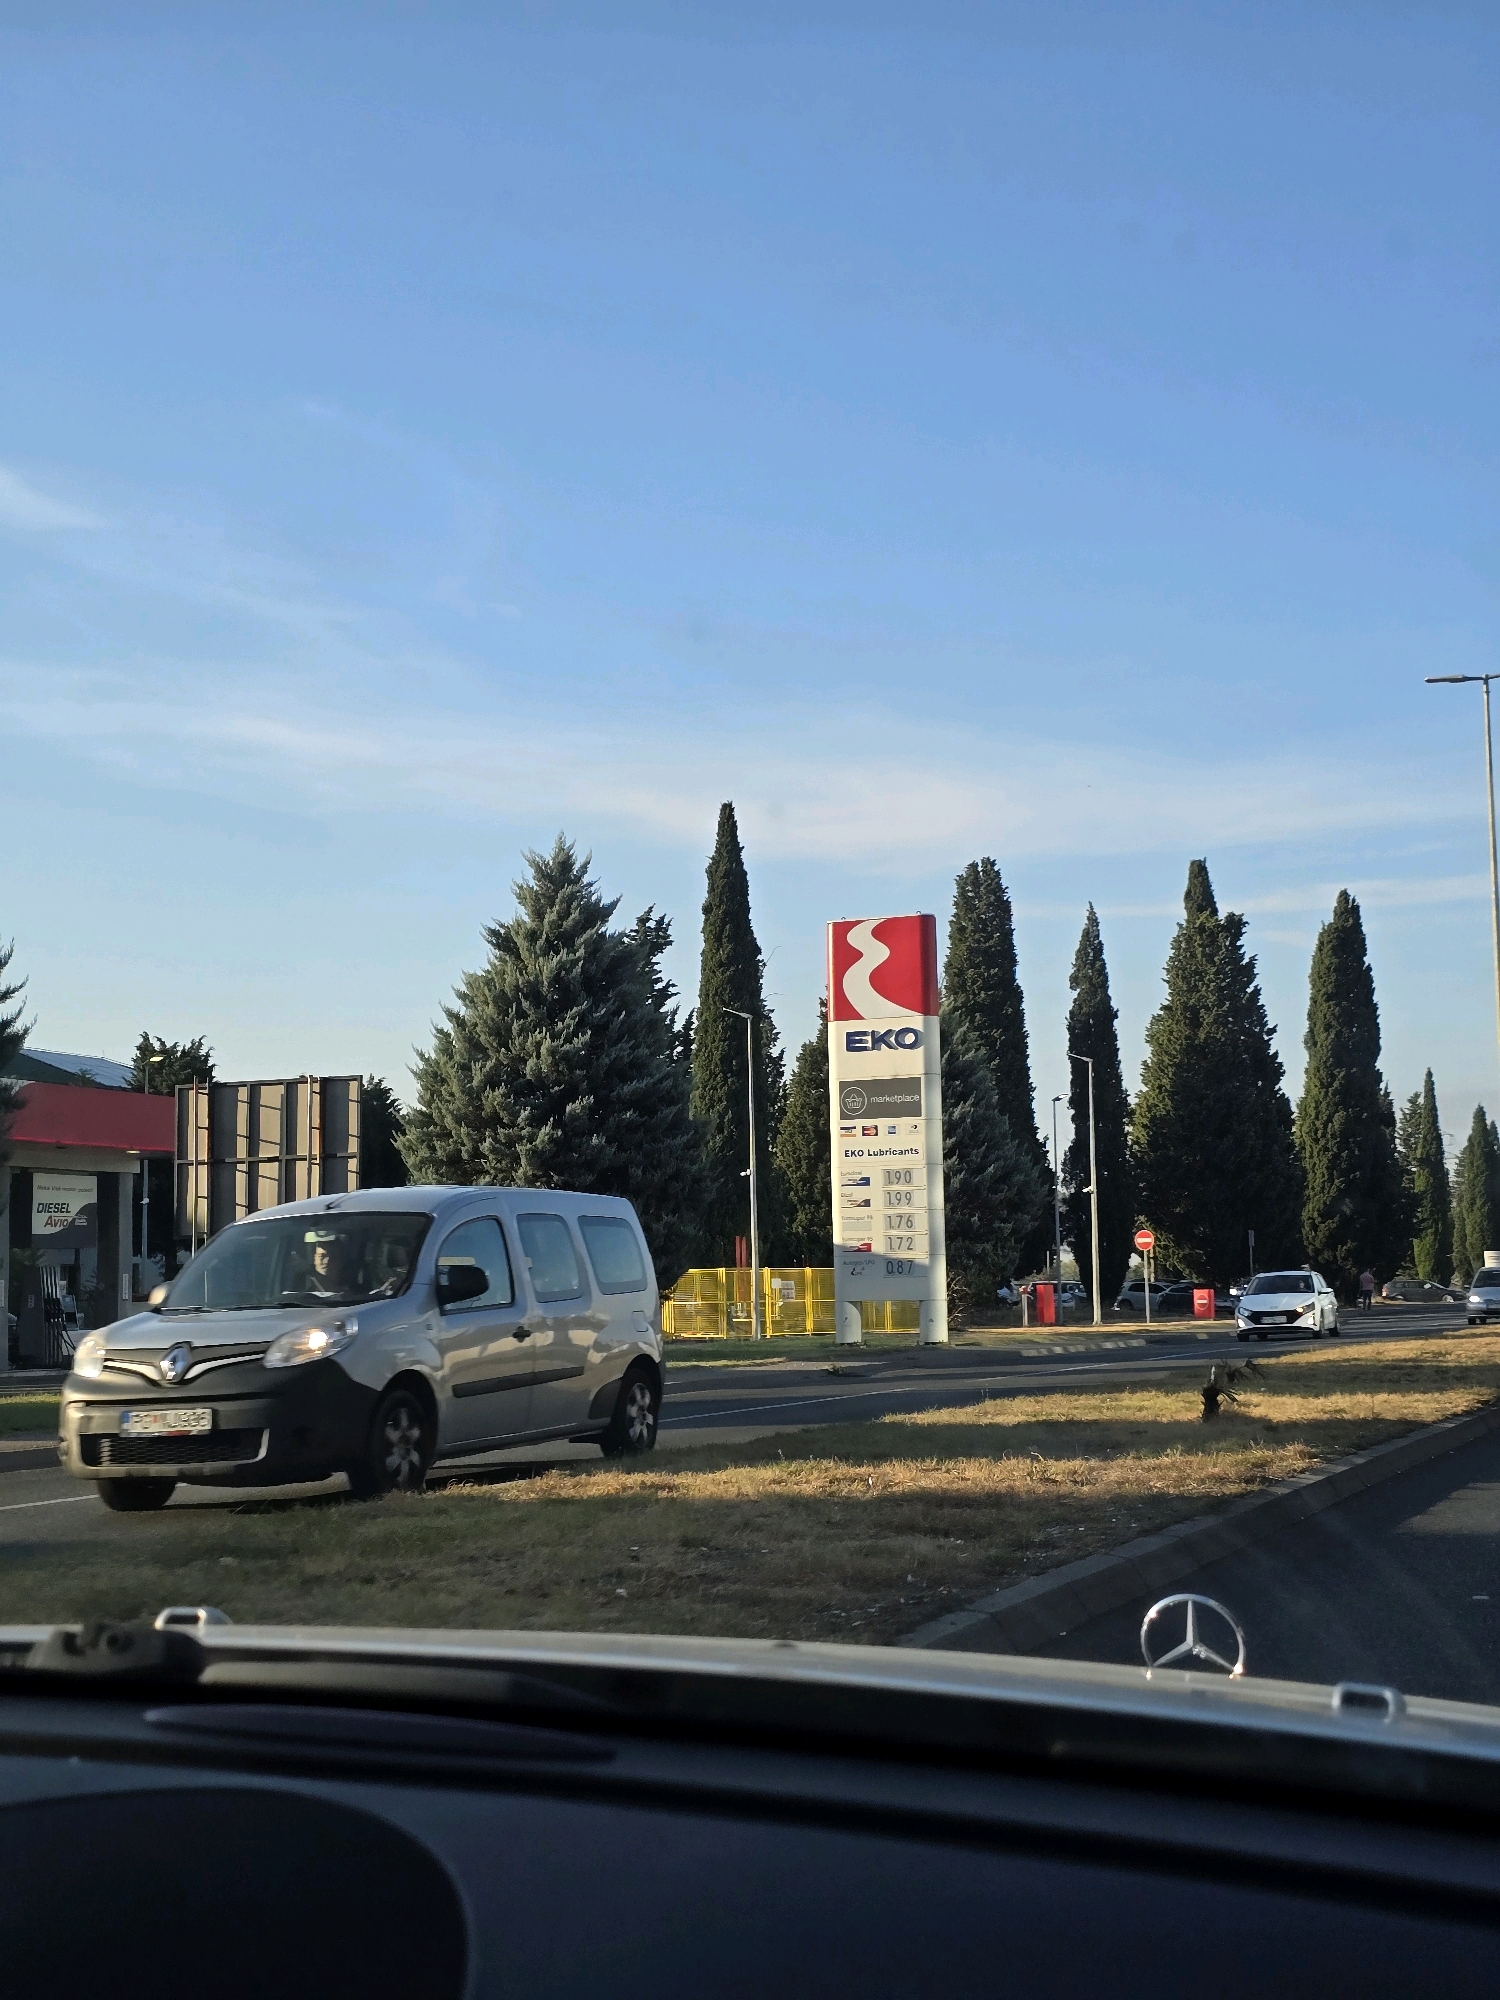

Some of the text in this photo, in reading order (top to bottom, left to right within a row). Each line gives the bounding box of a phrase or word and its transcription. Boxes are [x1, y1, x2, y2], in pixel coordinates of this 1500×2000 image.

[846, 1027, 921, 1052] EKO
[870, 1094, 919, 1104] marketplace
[844, 1147, 919, 1158] EKO Lubricants
[37, 1202, 71, 1213] DIESEL
[887, 1215, 913, 1229] 1.76
[888, 1237, 914, 1250] 1.72
